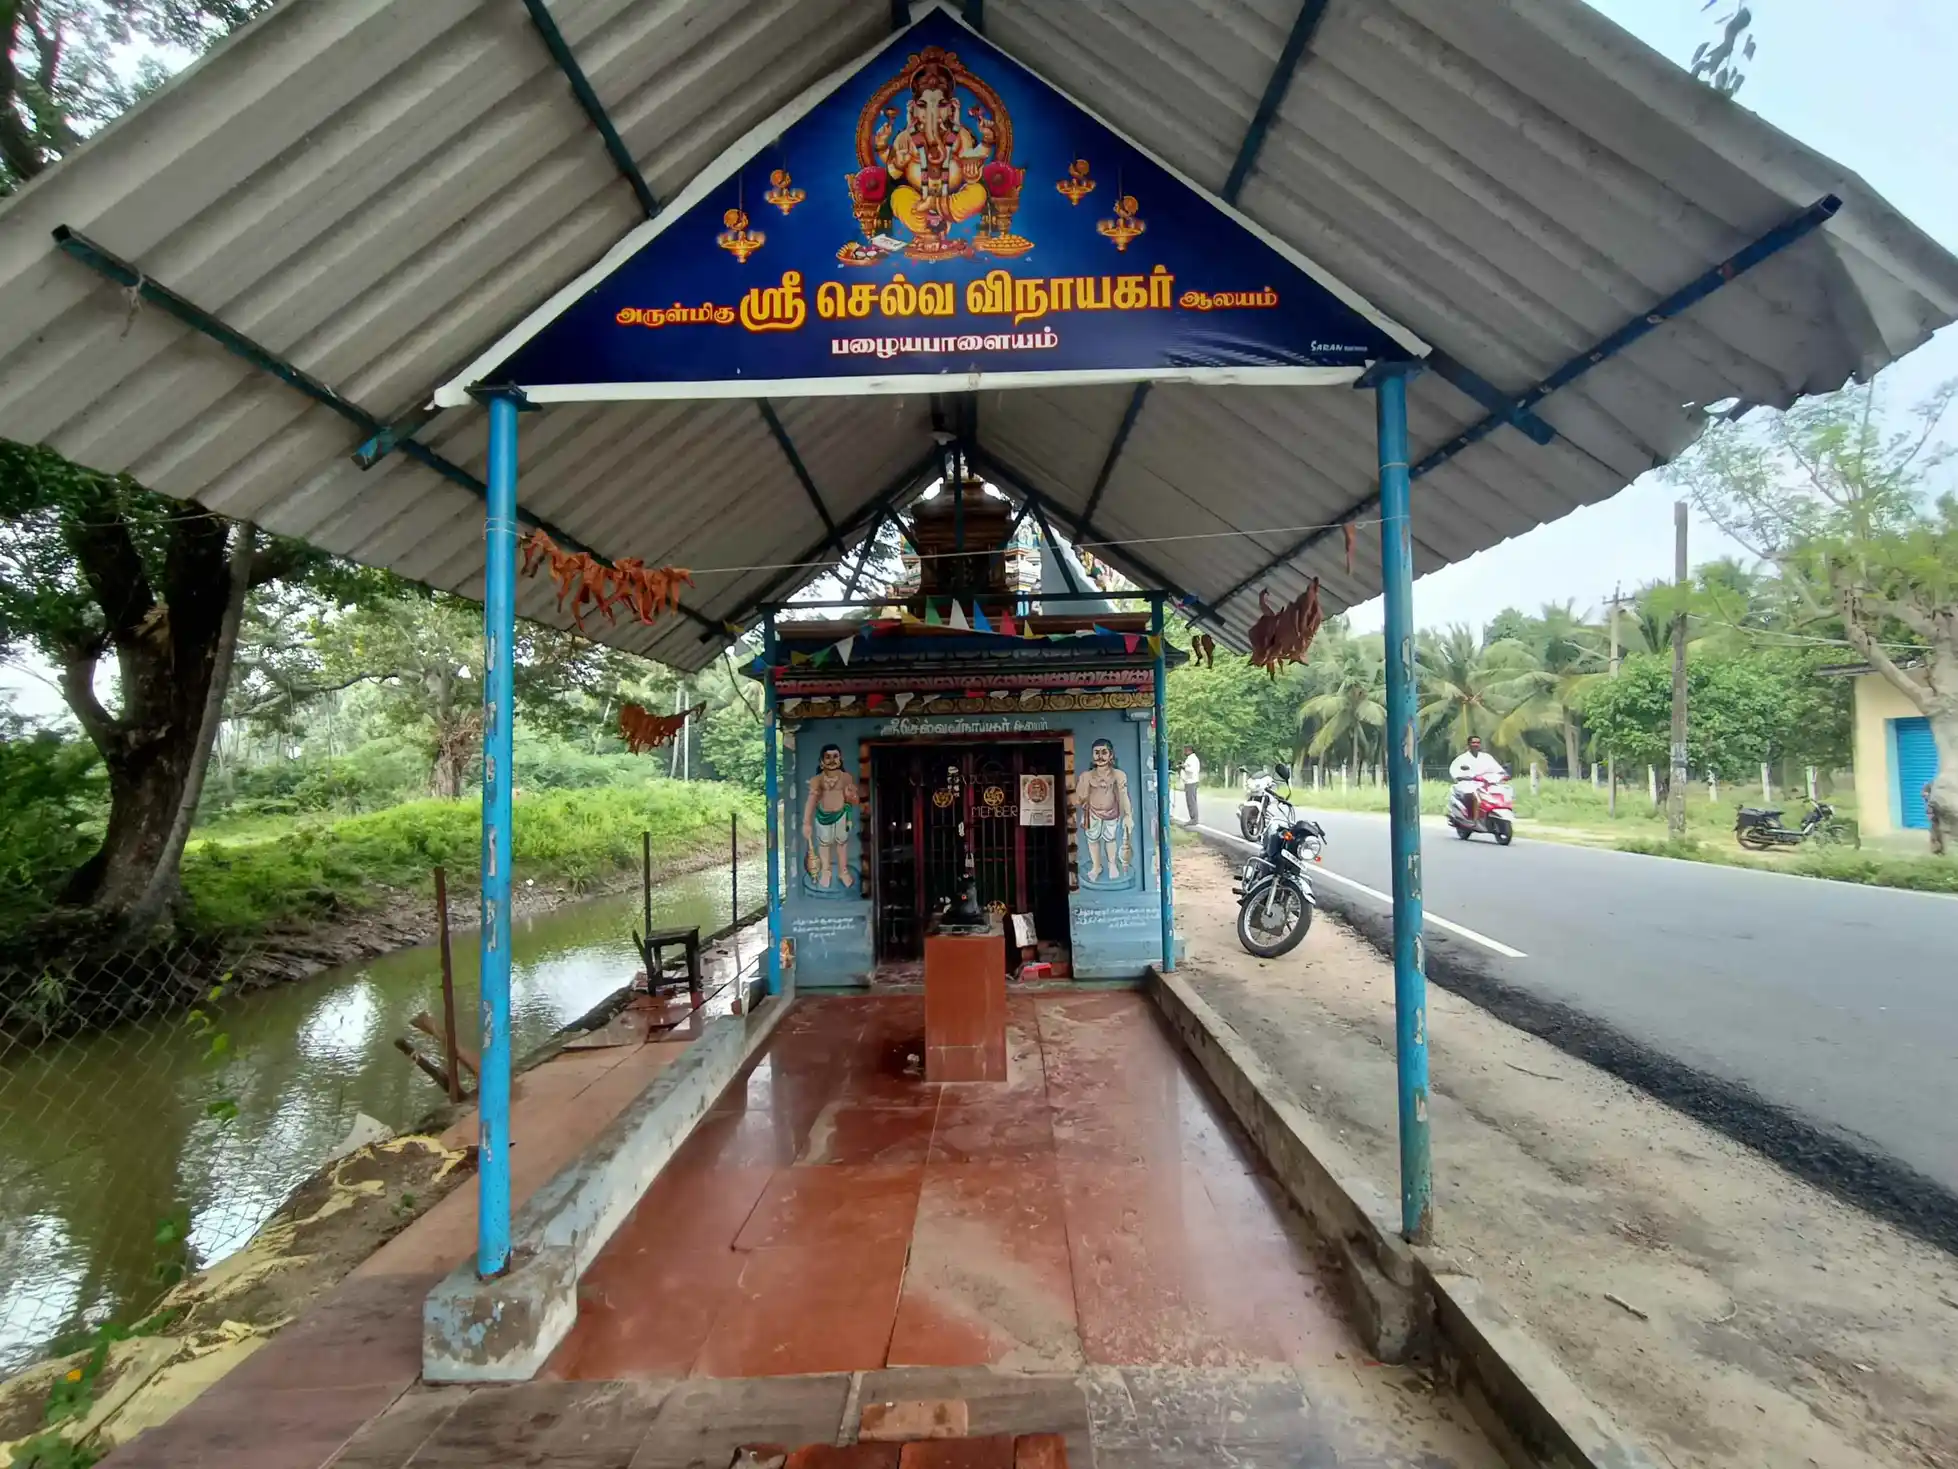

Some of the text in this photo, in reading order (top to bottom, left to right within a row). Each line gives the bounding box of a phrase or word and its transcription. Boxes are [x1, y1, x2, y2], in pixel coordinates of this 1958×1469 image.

[616, 303, 735, 326] அருள்மிகு
[816, 274, 955, 317] செல்வ
[966, 264, 1174, 326] விநாயகர்
[1179, 286, 1278, 309] ஆலயம்
[831, 326, 1058, 358] பழையபாளையம்
[1310, 340, 1344, 352] SARAN
[971, 805, 1018, 818] MEMBER
